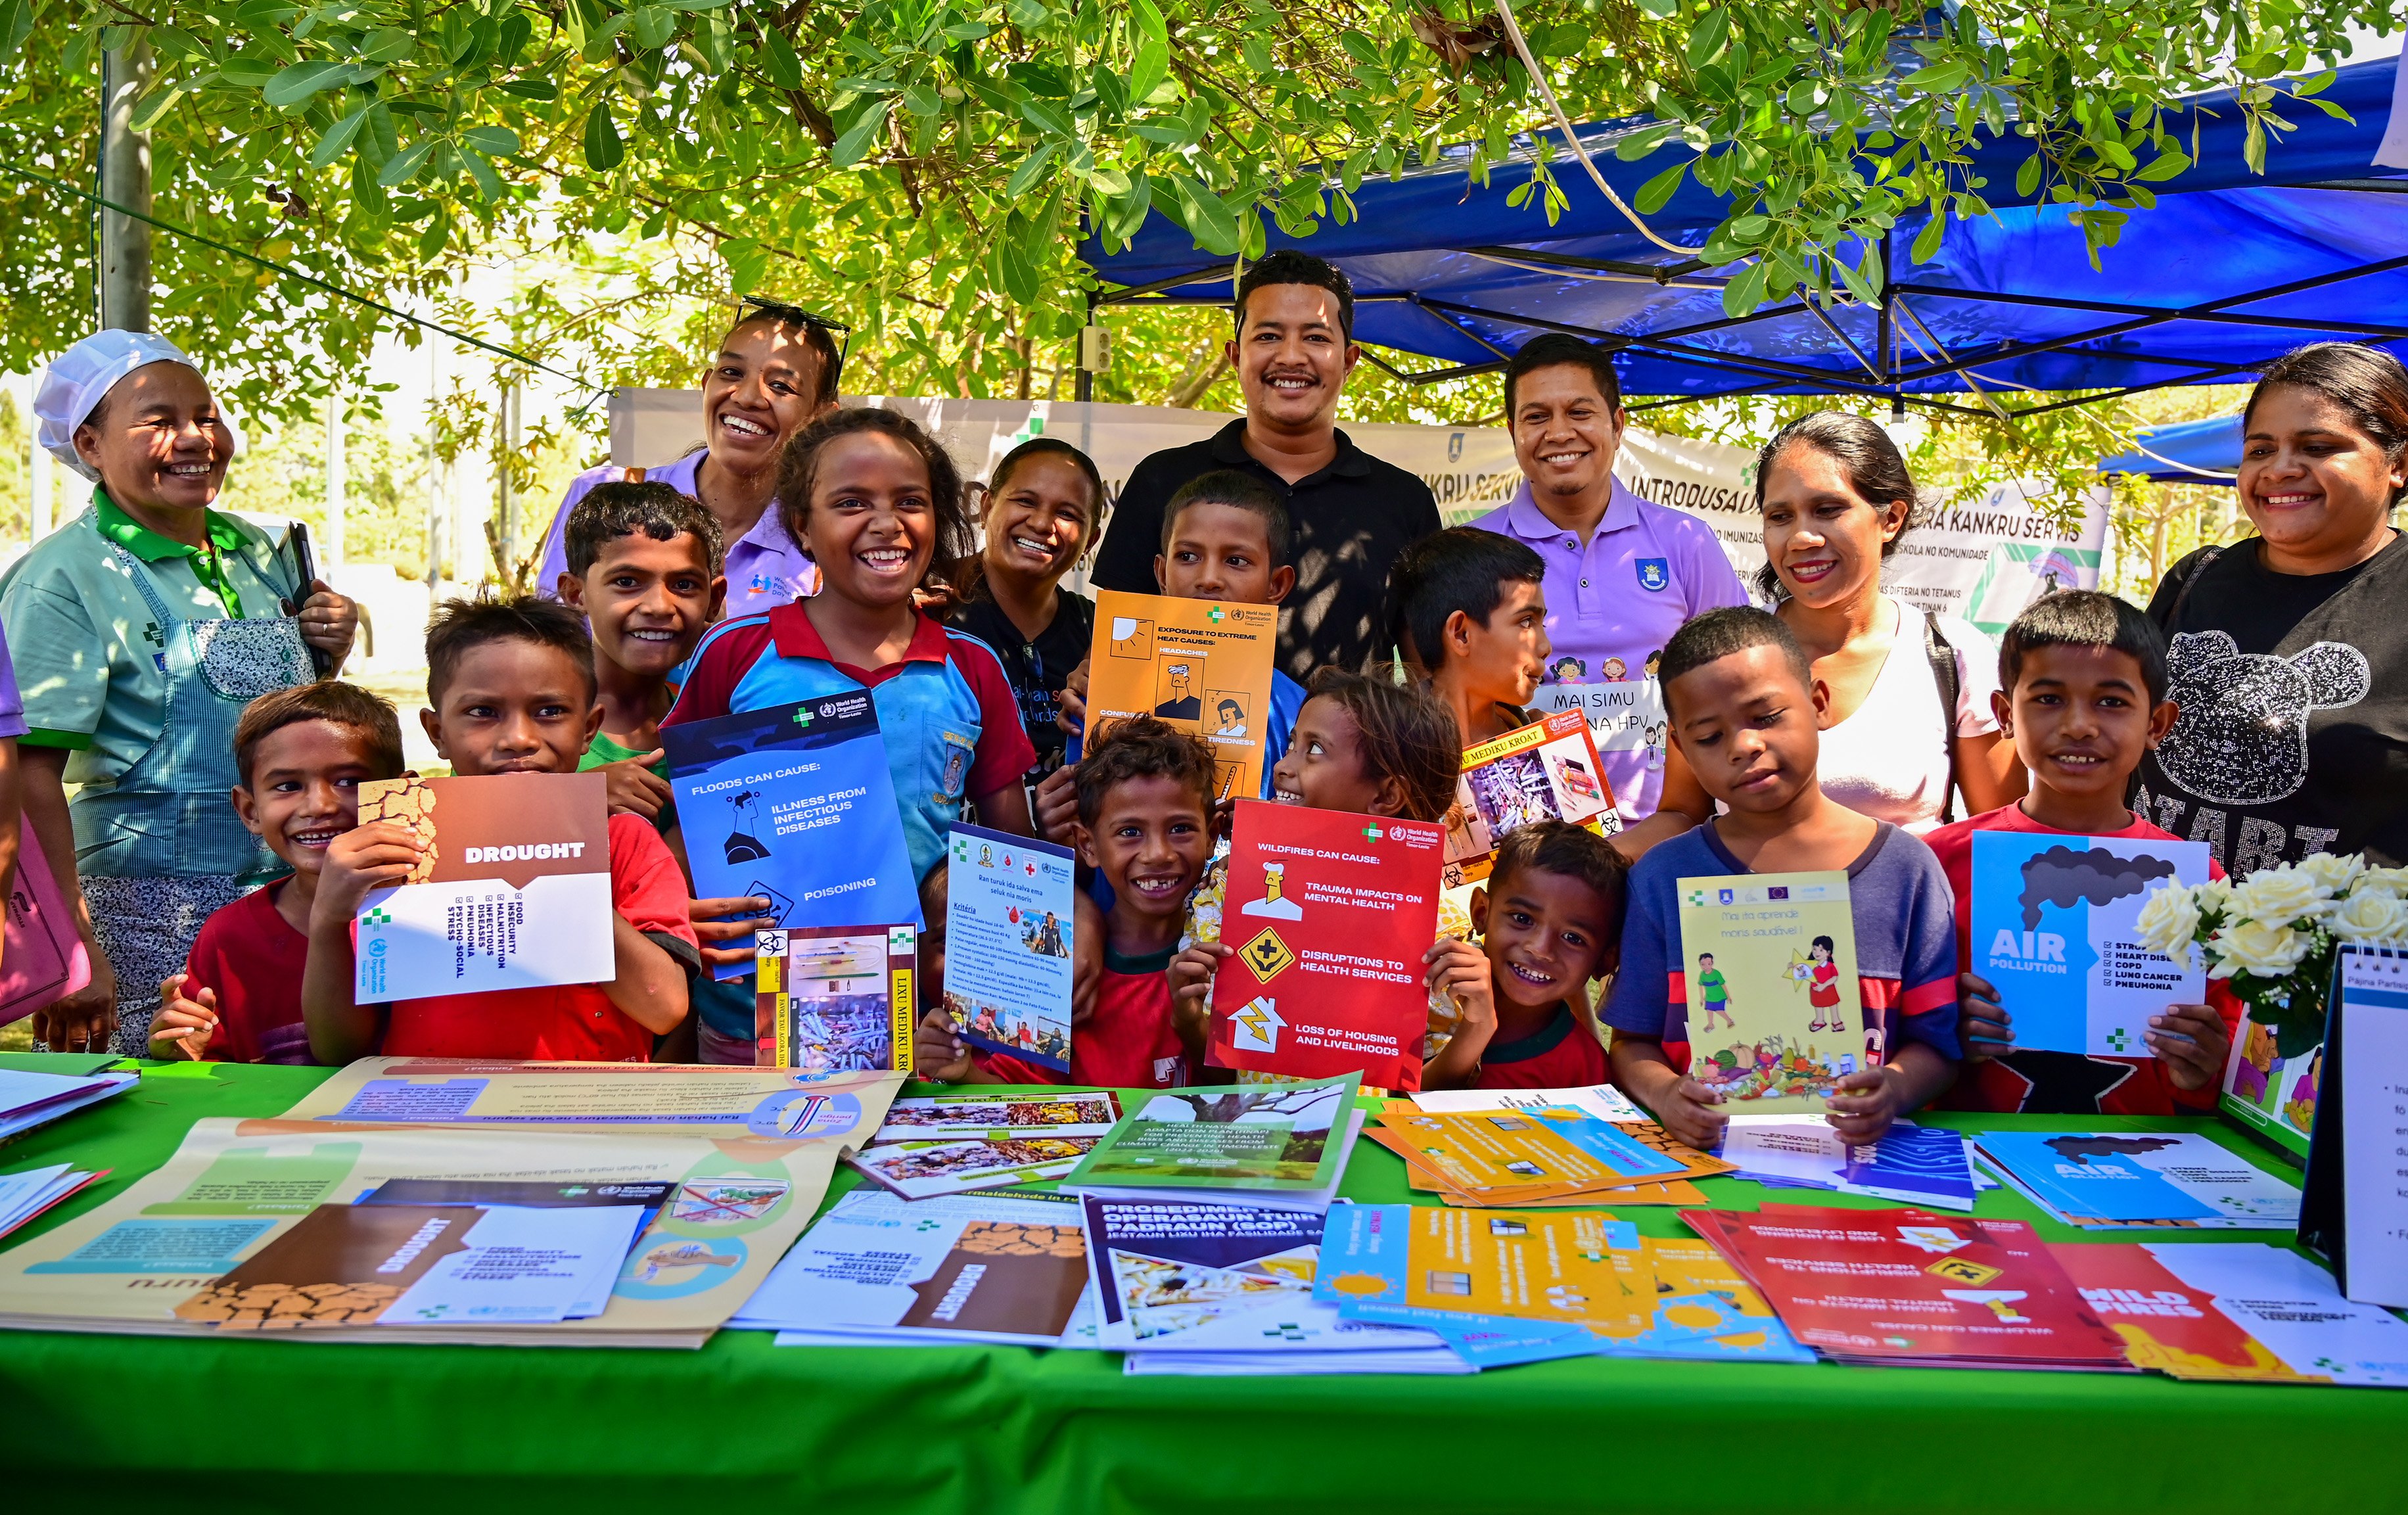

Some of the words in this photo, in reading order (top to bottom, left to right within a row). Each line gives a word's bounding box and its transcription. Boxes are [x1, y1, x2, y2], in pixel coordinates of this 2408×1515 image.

[1418, 473, 1469, 504] KRU
[1469, 473, 1523, 502] SERVI
[1949, 509, 2021, 536] KANKRU
[1896, 544, 1923, 555] SKOLA
[1925, 546, 1937, 557] NO
[1938, 547, 1989, 560] KOMUNIDADE
[1889, 586, 1919, 596] DIFTERIA
[1920, 588, 1930, 597] NO
[1932, 588, 1961, 599] TETANUS
[1922, 603, 1941, 613] TINAN
[1943, 604, 1947, 613] 6
[1158, 626, 1204, 636] EXPOSURE
[1218, 632, 1257, 640] EXTREME
[1180, 638, 1216, 646] CAUSES:
[1159, 647, 1209, 657] HEADACHES
[835, 698, 850, 709] World
[850, 696, 867, 705] Health
[837, 702, 868, 712] Organization
[1554, 694, 1586, 709] MAI
[1592, 691, 1634, 708] SIMU
[1618, 714, 1648, 731] HPV
[1207, 736, 1256, 746] TIREDNESS
[1470, 741, 1507, 762] MEDIKU
[1510, 731, 1539, 747] KROAT
[691, 778, 743, 796] FLOODS
[745, 772, 773, 785] CAN
[776, 762, 821, 779] CAUSE:
[772, 795, 826, 814] ILLNESS
[829, 787, 867, 802] FROM
[774, 801, 853, 825] INFECTIOUS
[776, 814, 841, 835] DISEASES
[1407, 827, 1422, 837] World
[1422, 829, 1438, 838] Health
[1406, 834, 1438, 844] Organization
[465, 842, 585, 864] DROUGHT
[1258, 843, 1314, 856] WILDFIRES
[1316, 849, 1339, 860] CAN
[1341, 852, 1380, 864] CAUSE:
[804, 877, 877, 901] POISONING
[979, 874, 990, 883] Ran
[990, 877, 1006, 887] turuk
[1006, 880, 1015, 889] ida
[1016, 884, 1030, 893] salva
[991, 887, 1006, 898] seluk
[1016, 895, 1032, 903] moris
[1306, 882, 1353, 895] TRAUMA
[1355, 888, 1404, 902] IMPACTS
[1405, 895, 1422, 903] ON
[954, 902, 977, 914] Kritéria
[1304, 893, 1349, 906] MENTAL
[1351, 898, 1395, 911] HEALTH
[1757, 909, 1798, 920] aprende
[467, 905, 475, 958] PNEUMONIA
[485, 904, 494, 956] INFECTIOUS
[497, 903, 505, 969] MALNUTRITION
[507, 902, 517, 954] INSECURITY
[1721, 928, 1749, 937] moris
[1753, 925, 1797, 937] saudável
[455, 906, 464, 979] PSYCHO-SOCIAL
[1989, 929, 2066, 962] AIR
[1301, 950, 1383, 968] DISRUPTIONS
[1387, 960, 1404, 971] TO
[2116, 952, 2148, 961] HEART
[1300, 962, 1349, 977] HEALTH
[1351, 968, 1412, 984] SERVICES
[1989, 958, 2067, 974] POLLUTION
[2142, 973, 2182, 982] CANCER
[2348, 976, 2375, 986] Pájina
[897, 977, 906, 1004] LIXU
[2115, 981, 2173, 991] PNEUMONIA
[898, 1006, 908, 1050] MEDIKU
[1295, 1023, 1326, 1036] LOSS
[1327, 1027, 1343, 1037] OF
[1345, 1030, 1397, 1044] HOUSING
[1296, 1036, 1322, 1047] AND
[1323, 1038, 1399, 1057] LIVELIHOODS
[2054, 1164, 2133, 1176] AIR
[1103, 1213, 1255, 1223] OPERASAUN
[1105, 1223, 1227, 1232] PADRAUN
[1232, 1221, 1298, 1231] (SOP)
[1228, 1229, 1304, 1238] FASILIDADE
[1755, 1230, 1824, 1240] HOUSING
[376, 1217, 452, 1273] DROUGHT
[1766, 1257, 1847, 1268] SERVICES
[1782, 1263, 1807, 1272] TO
[1809, 1265, 1922, 1278] DISRUPTIONS
[931, 1264, 987, 1322] DROUGHT
[2077, 1287, 2190, 1305] WILD
[1792, 1297, 1817, 1306] ON
[2088, 1300, 2204, 1317] FIRES
[1871, 1321, 1930, 1332] CAUSE:
[1931, 1324, 1966, 1333] CAN
[1968, 1325, 2053, 1336] WILDFIRES
